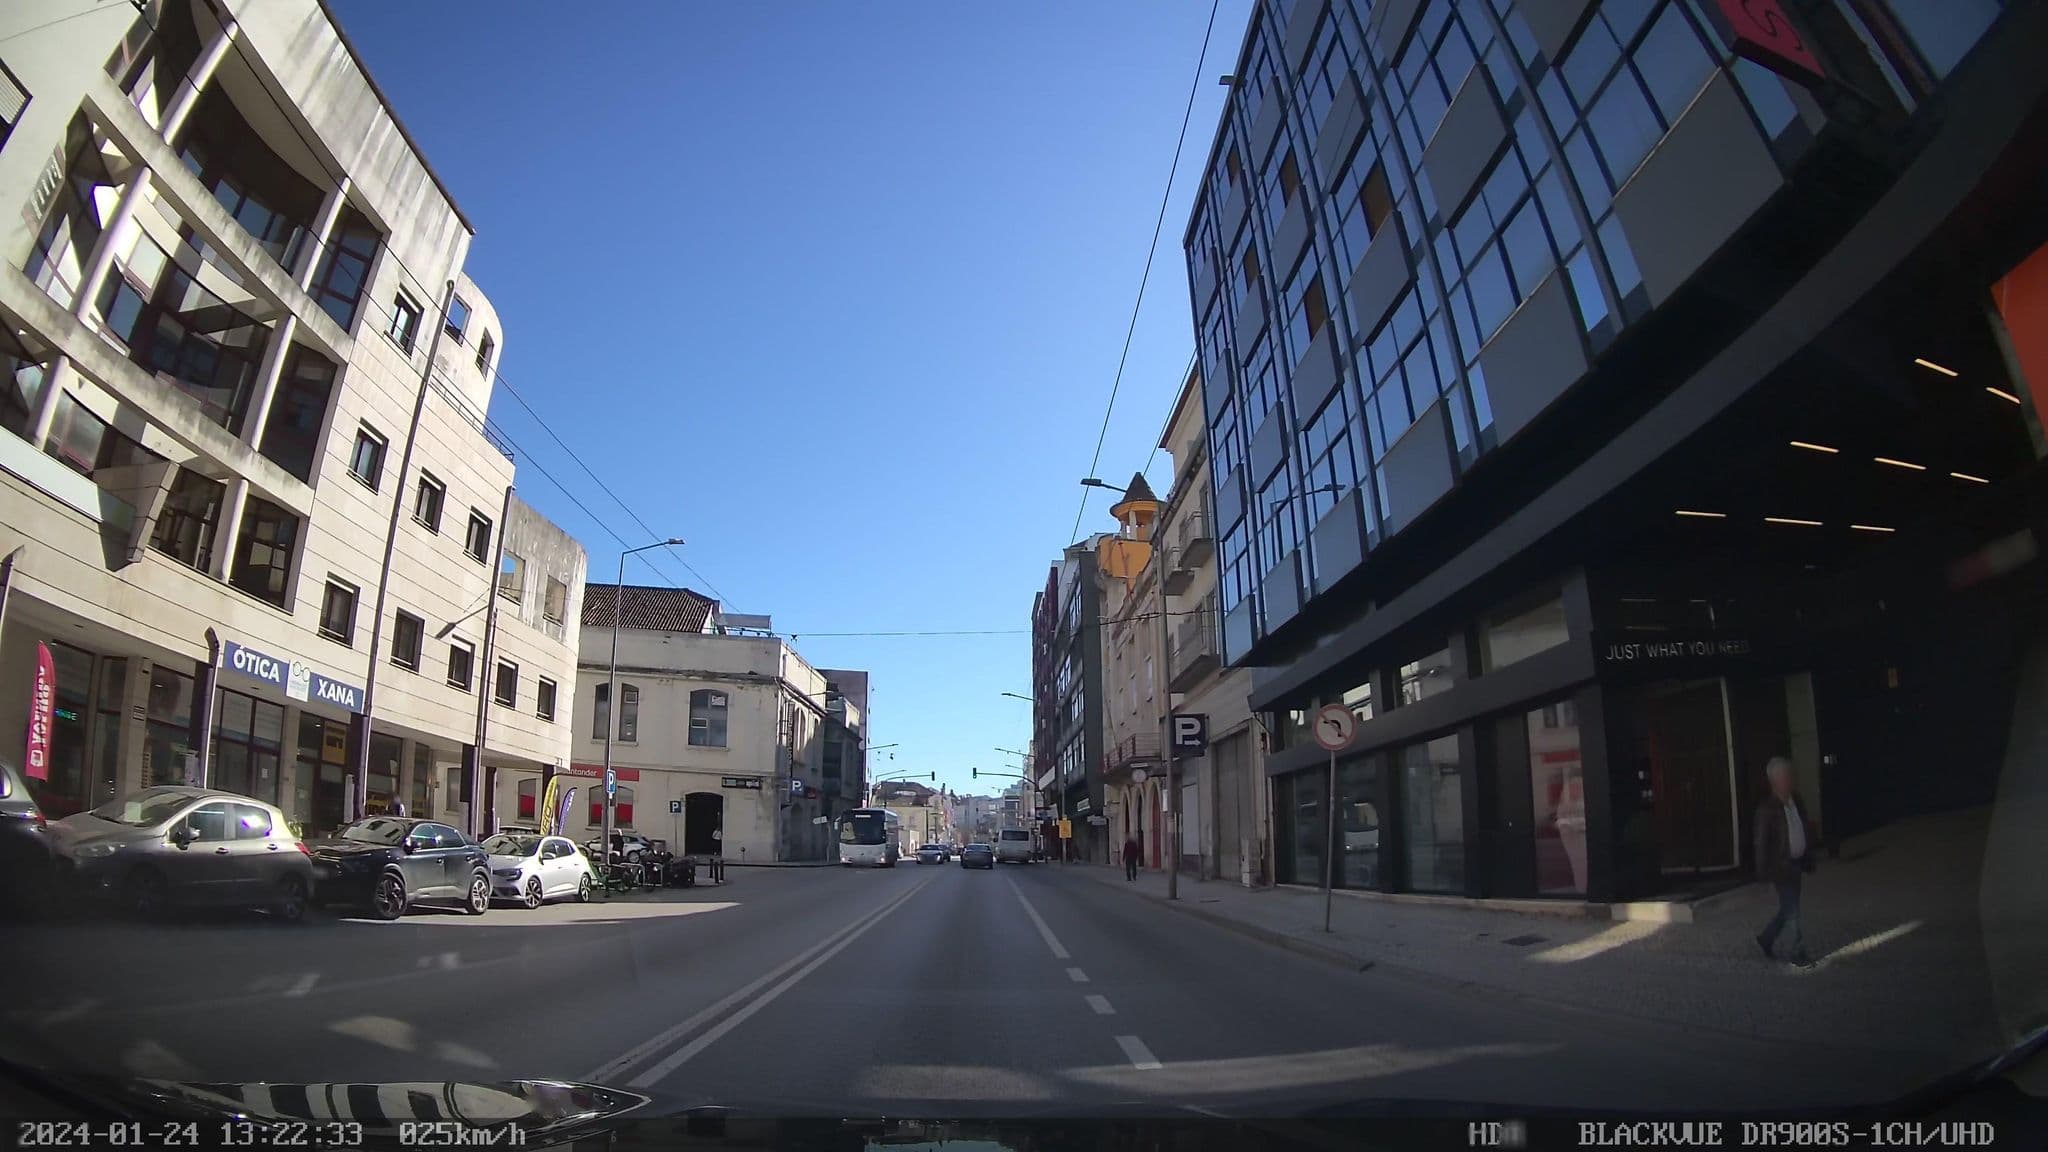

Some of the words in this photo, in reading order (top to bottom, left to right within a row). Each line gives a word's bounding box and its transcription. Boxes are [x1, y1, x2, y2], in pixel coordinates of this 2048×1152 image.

[1606, 643, 1641, 660] JUST
[1645, 642, 1684, 658] WHAT
[1689, 640, 1715, 656] YOU
[233, 645, 281, 683] ÓTICA
[317, 678, 355, 707] XANA
[1175, 717, 1201, 745] P
[608, 774, 614, 790] P
[672, 802, 679, 812] P
